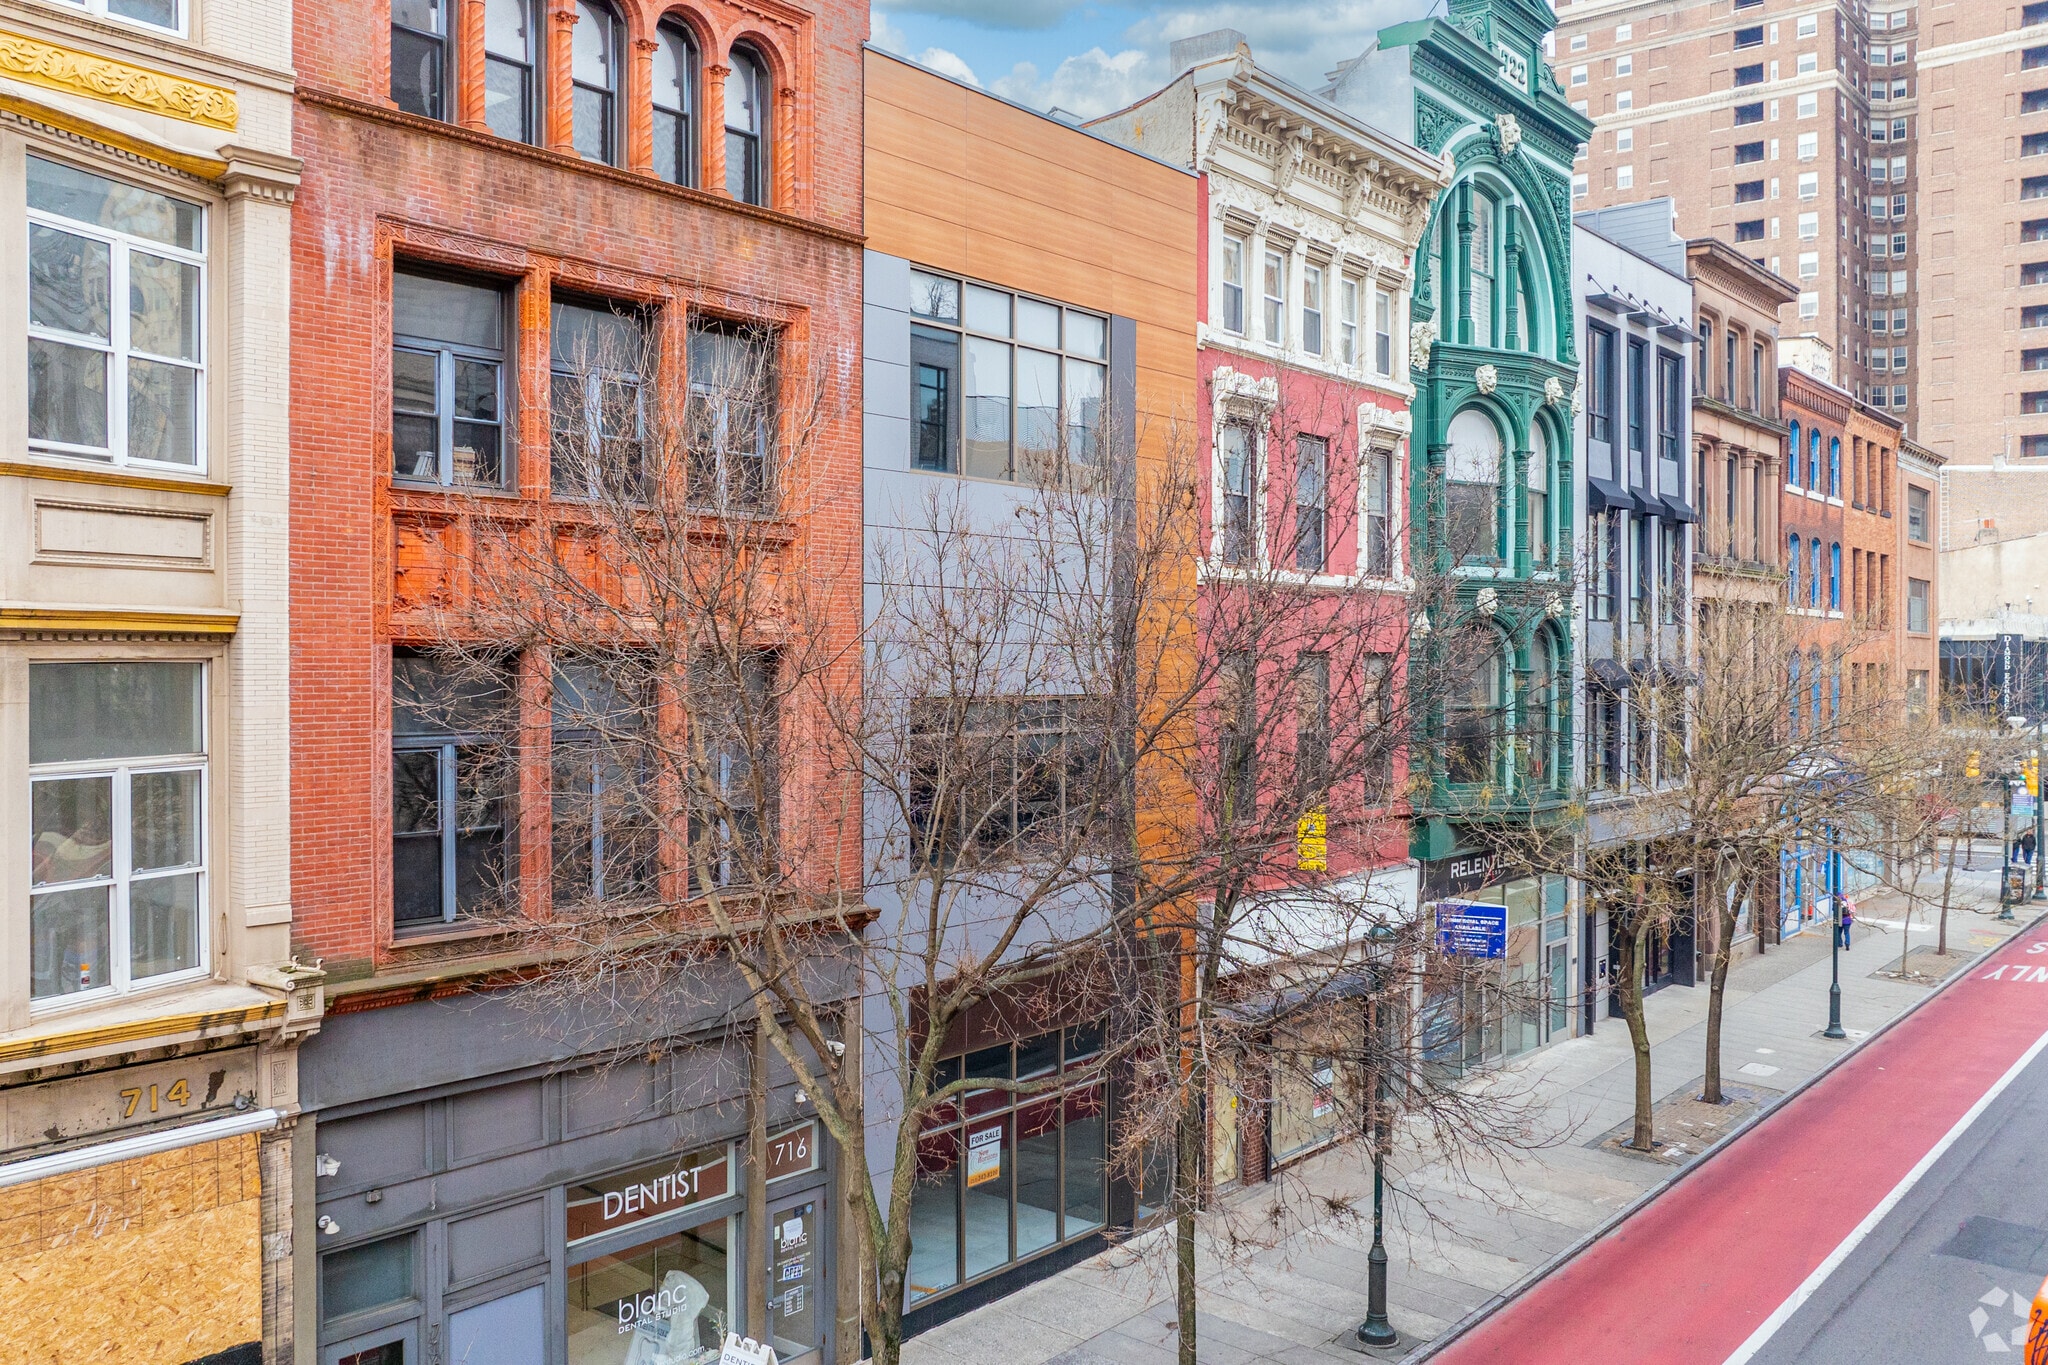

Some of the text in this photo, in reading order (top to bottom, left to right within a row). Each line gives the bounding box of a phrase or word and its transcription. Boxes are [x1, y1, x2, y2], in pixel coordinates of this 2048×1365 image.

[1501, 50, 1525, 85] 722
[2003, 635, 2012, 671] DIAMOND
[120, 1078, 192, 1119] 714
[774, 1137, 808, 1166] 716
[971, 1129, 1000, 1145] FOR SALE
[603, 1165, 702, 1221] DENTIST
[617, 1317, 653, 1335] DENTAL
[655, 1303, 688, 1321] STUDIO
[618, 1284, 687, 1324] blanc
[723, 1353, 756, 1365] DENT
